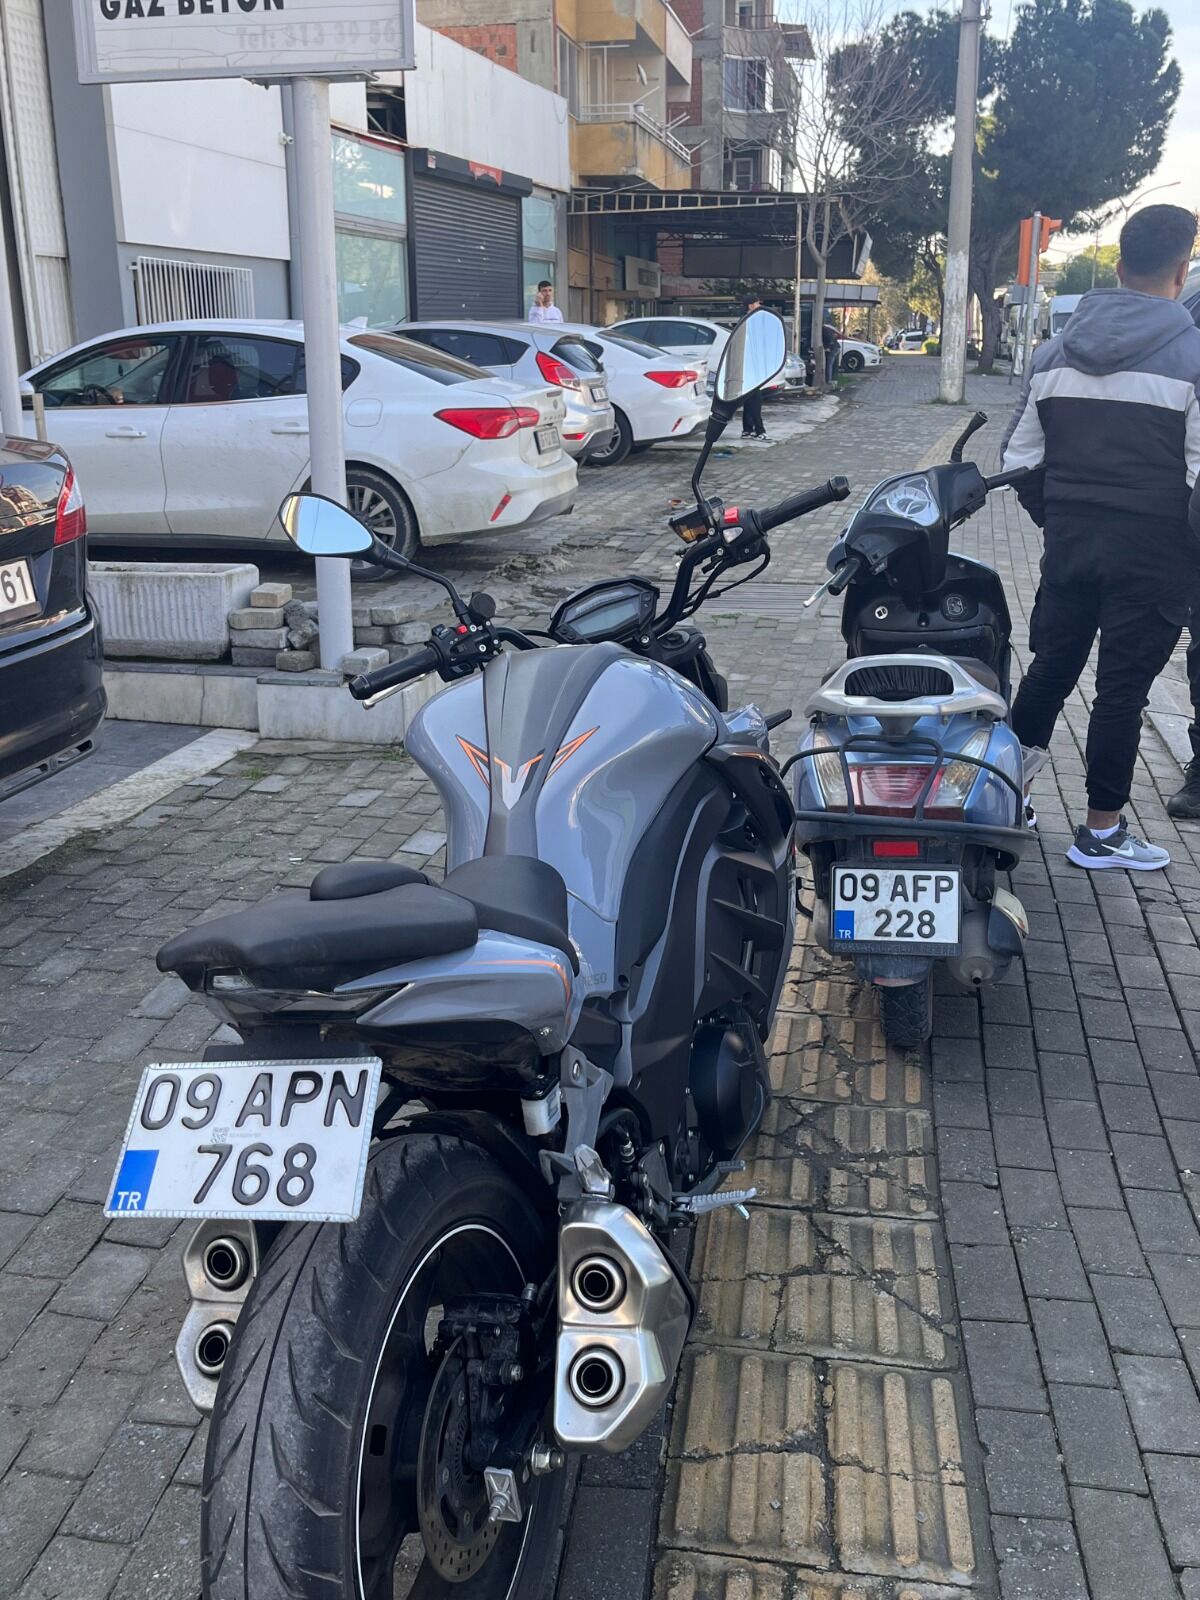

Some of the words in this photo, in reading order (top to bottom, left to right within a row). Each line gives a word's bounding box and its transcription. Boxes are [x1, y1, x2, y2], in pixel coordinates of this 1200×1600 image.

[236, 25, 275, 49] Tel:
[278, 22, 324, 47] 313
[362, 18, 396, 44] 56
[1, 566, 28, 604] 61
[839, 872, 879, 902] 09
[890, 874, 954, 903] AFP
[839, 929, 851, 939] TR
[874, 908, 936, 938] 228
[141, 1072, 222, 1130] 09
[235, 1069, 368, 1128] APN
[194, 1141, 318, 1207] 768
[117, 1191, 142, 1210] TR
